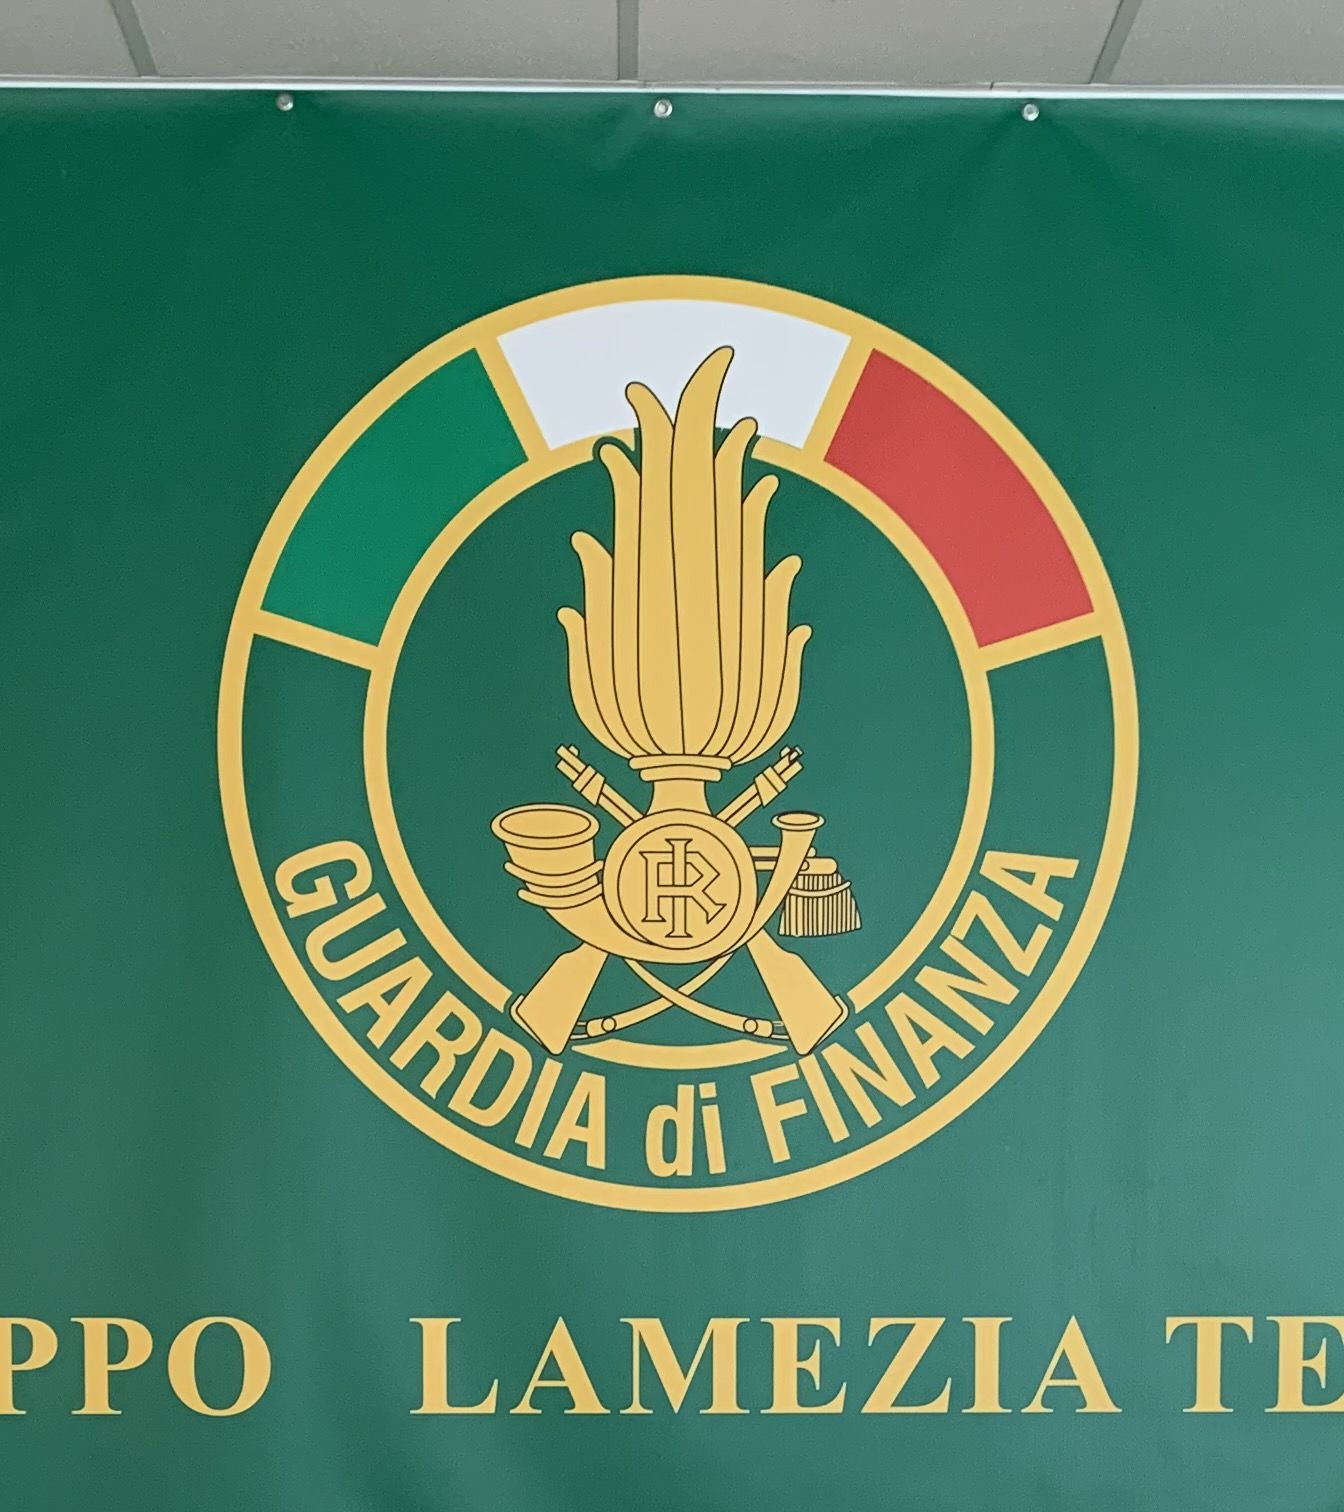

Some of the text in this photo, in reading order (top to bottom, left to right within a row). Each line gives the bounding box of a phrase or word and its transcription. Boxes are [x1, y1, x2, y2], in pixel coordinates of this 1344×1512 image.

[274, 839, 1079, 1177] GUARDIA di FINANZA
[417, 1316, 1117, 1415] LAMEZIA
